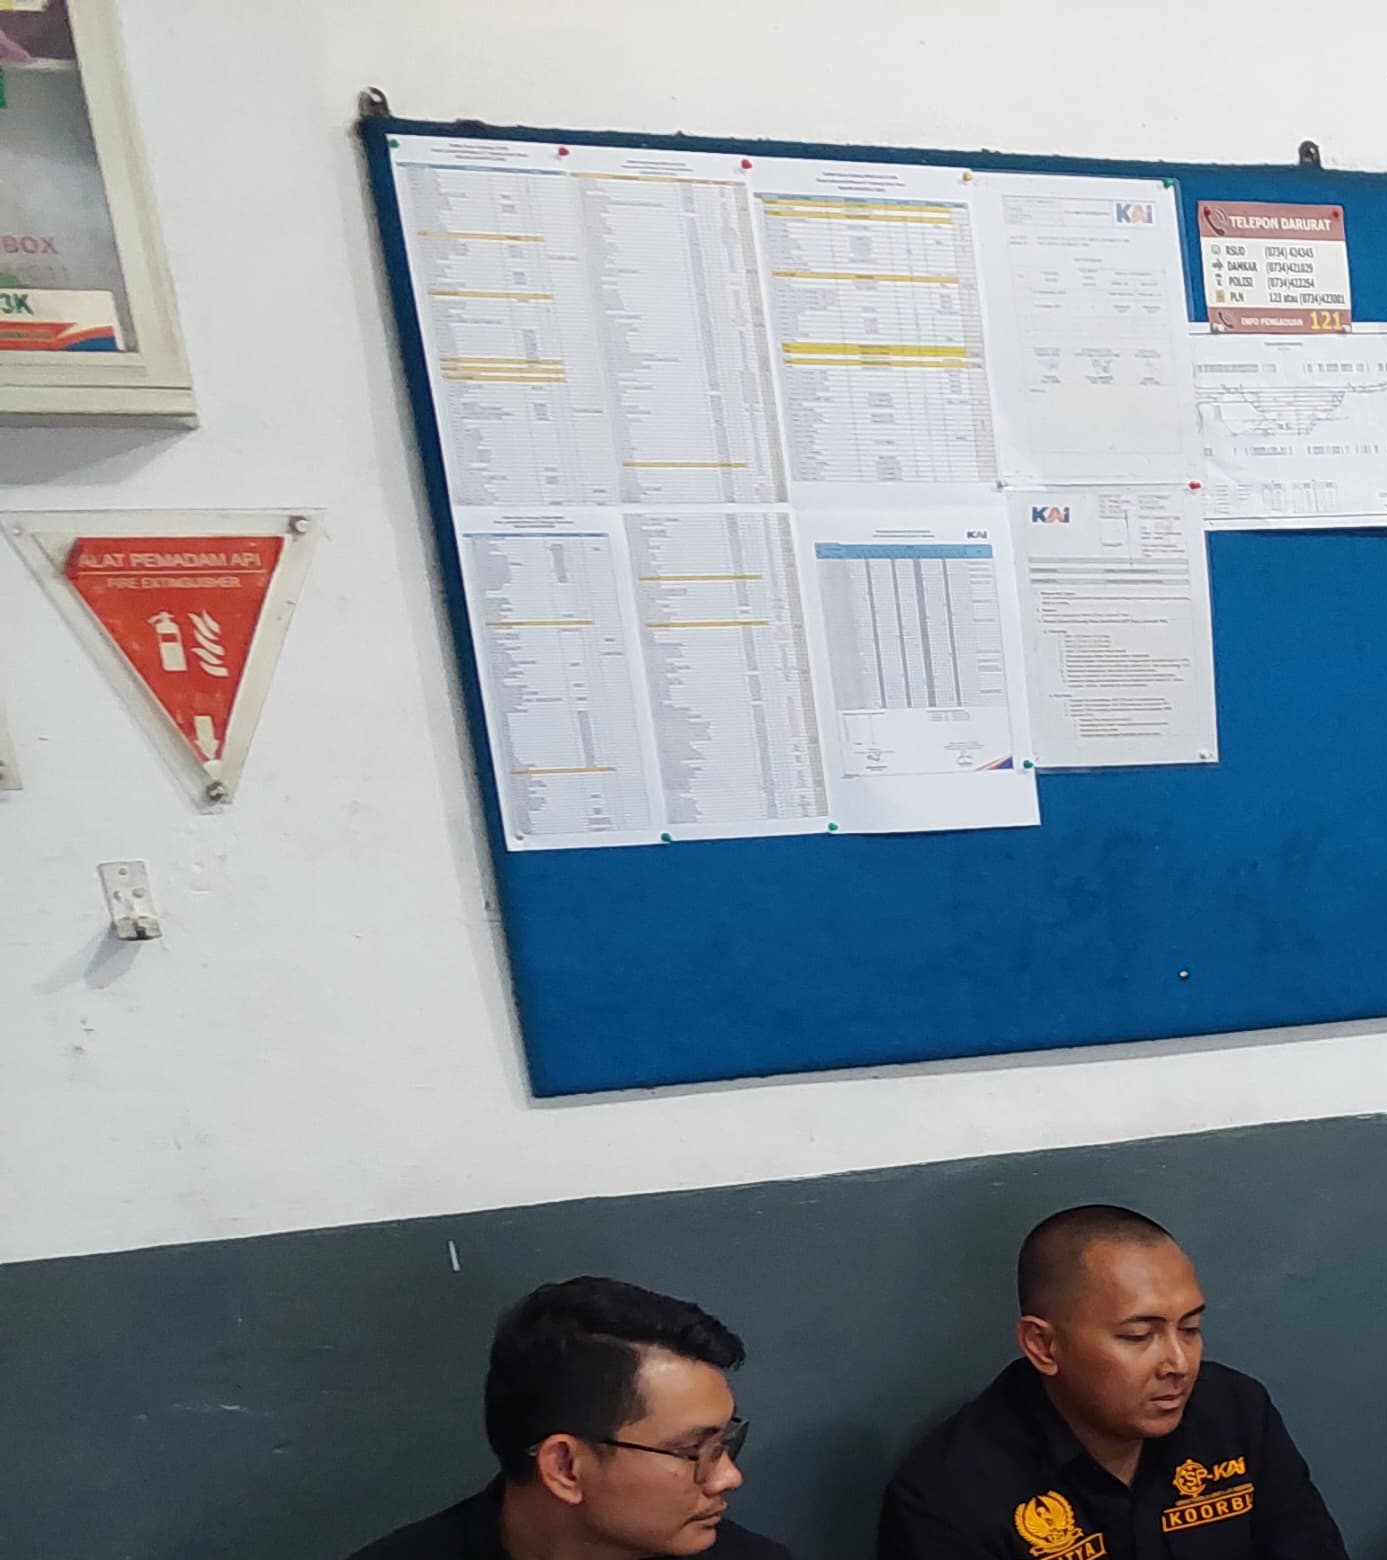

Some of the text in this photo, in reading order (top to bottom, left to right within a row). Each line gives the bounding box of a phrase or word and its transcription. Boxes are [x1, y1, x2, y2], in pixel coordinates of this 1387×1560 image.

[1228, 215, 1332, 231] TELEPON DARURAT
[0, 235, 58, 254] BOX
[1227, 261, 1257, 272] DAMKAR
[1228, 276, 1253, 288] POLISI
[1230, 291, 1244, 303] PLN
[1310, 310, 1343, 330] 121
[79, 552, 262, 568] ALAT PEMADAM API
[106, 576, 241, 589] FIRE EXTINGUISHER
